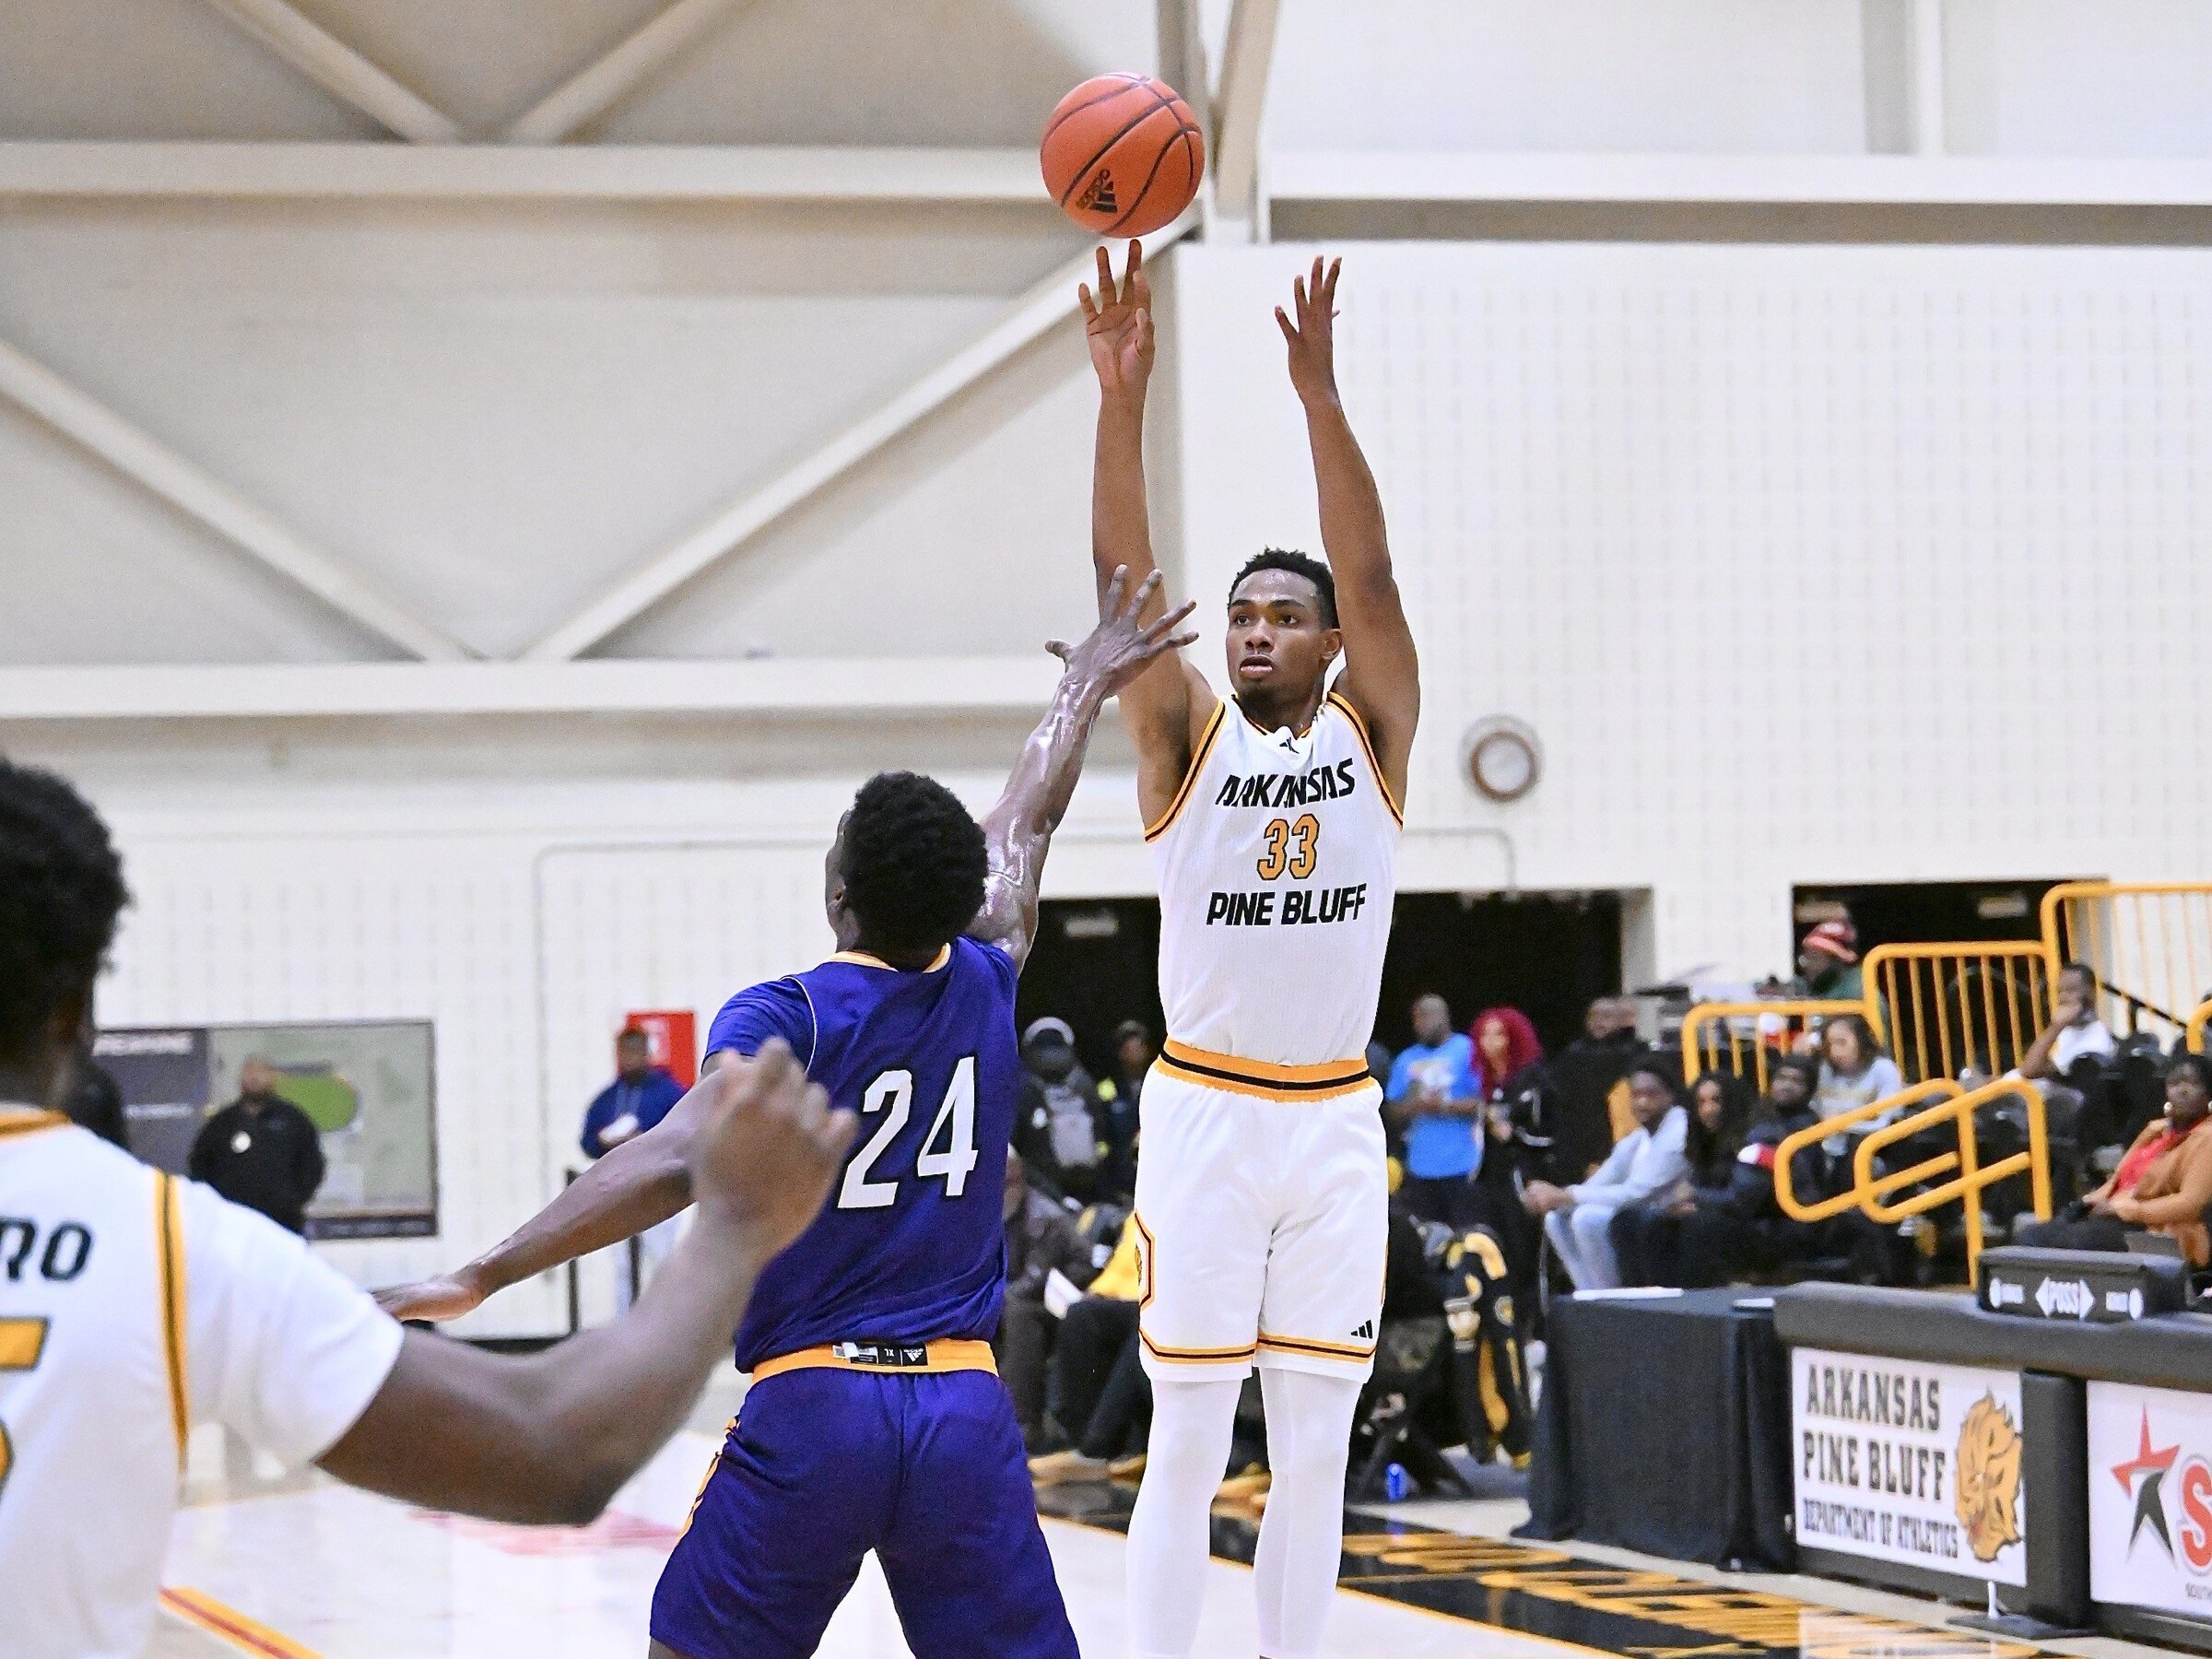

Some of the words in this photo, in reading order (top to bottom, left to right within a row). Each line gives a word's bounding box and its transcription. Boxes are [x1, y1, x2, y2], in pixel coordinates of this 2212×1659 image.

[1215, 758, 1356, 808] ARKANSAS
[1256, 813, 1321, 881] 33
[1206, 891, 1277, 926] PINE
[1280, 883, 1368, 925] BLUFF
[836, 1055, 980, 1210] 24
[2048, 1280, 2080, 1315] POSS
[1806, 1364, 1941, 1430] ARKANSAS
[1804, 1430, 1859, 1488] PINE
[1868, 1438, 1947, 1500] BLUFF
[1803, 1497, 1877, 1543] DEPARTMENT
[1880, 1512, 1893, 1547] OF
[1898, 1515, 1959, 1559] ATHLETICS
